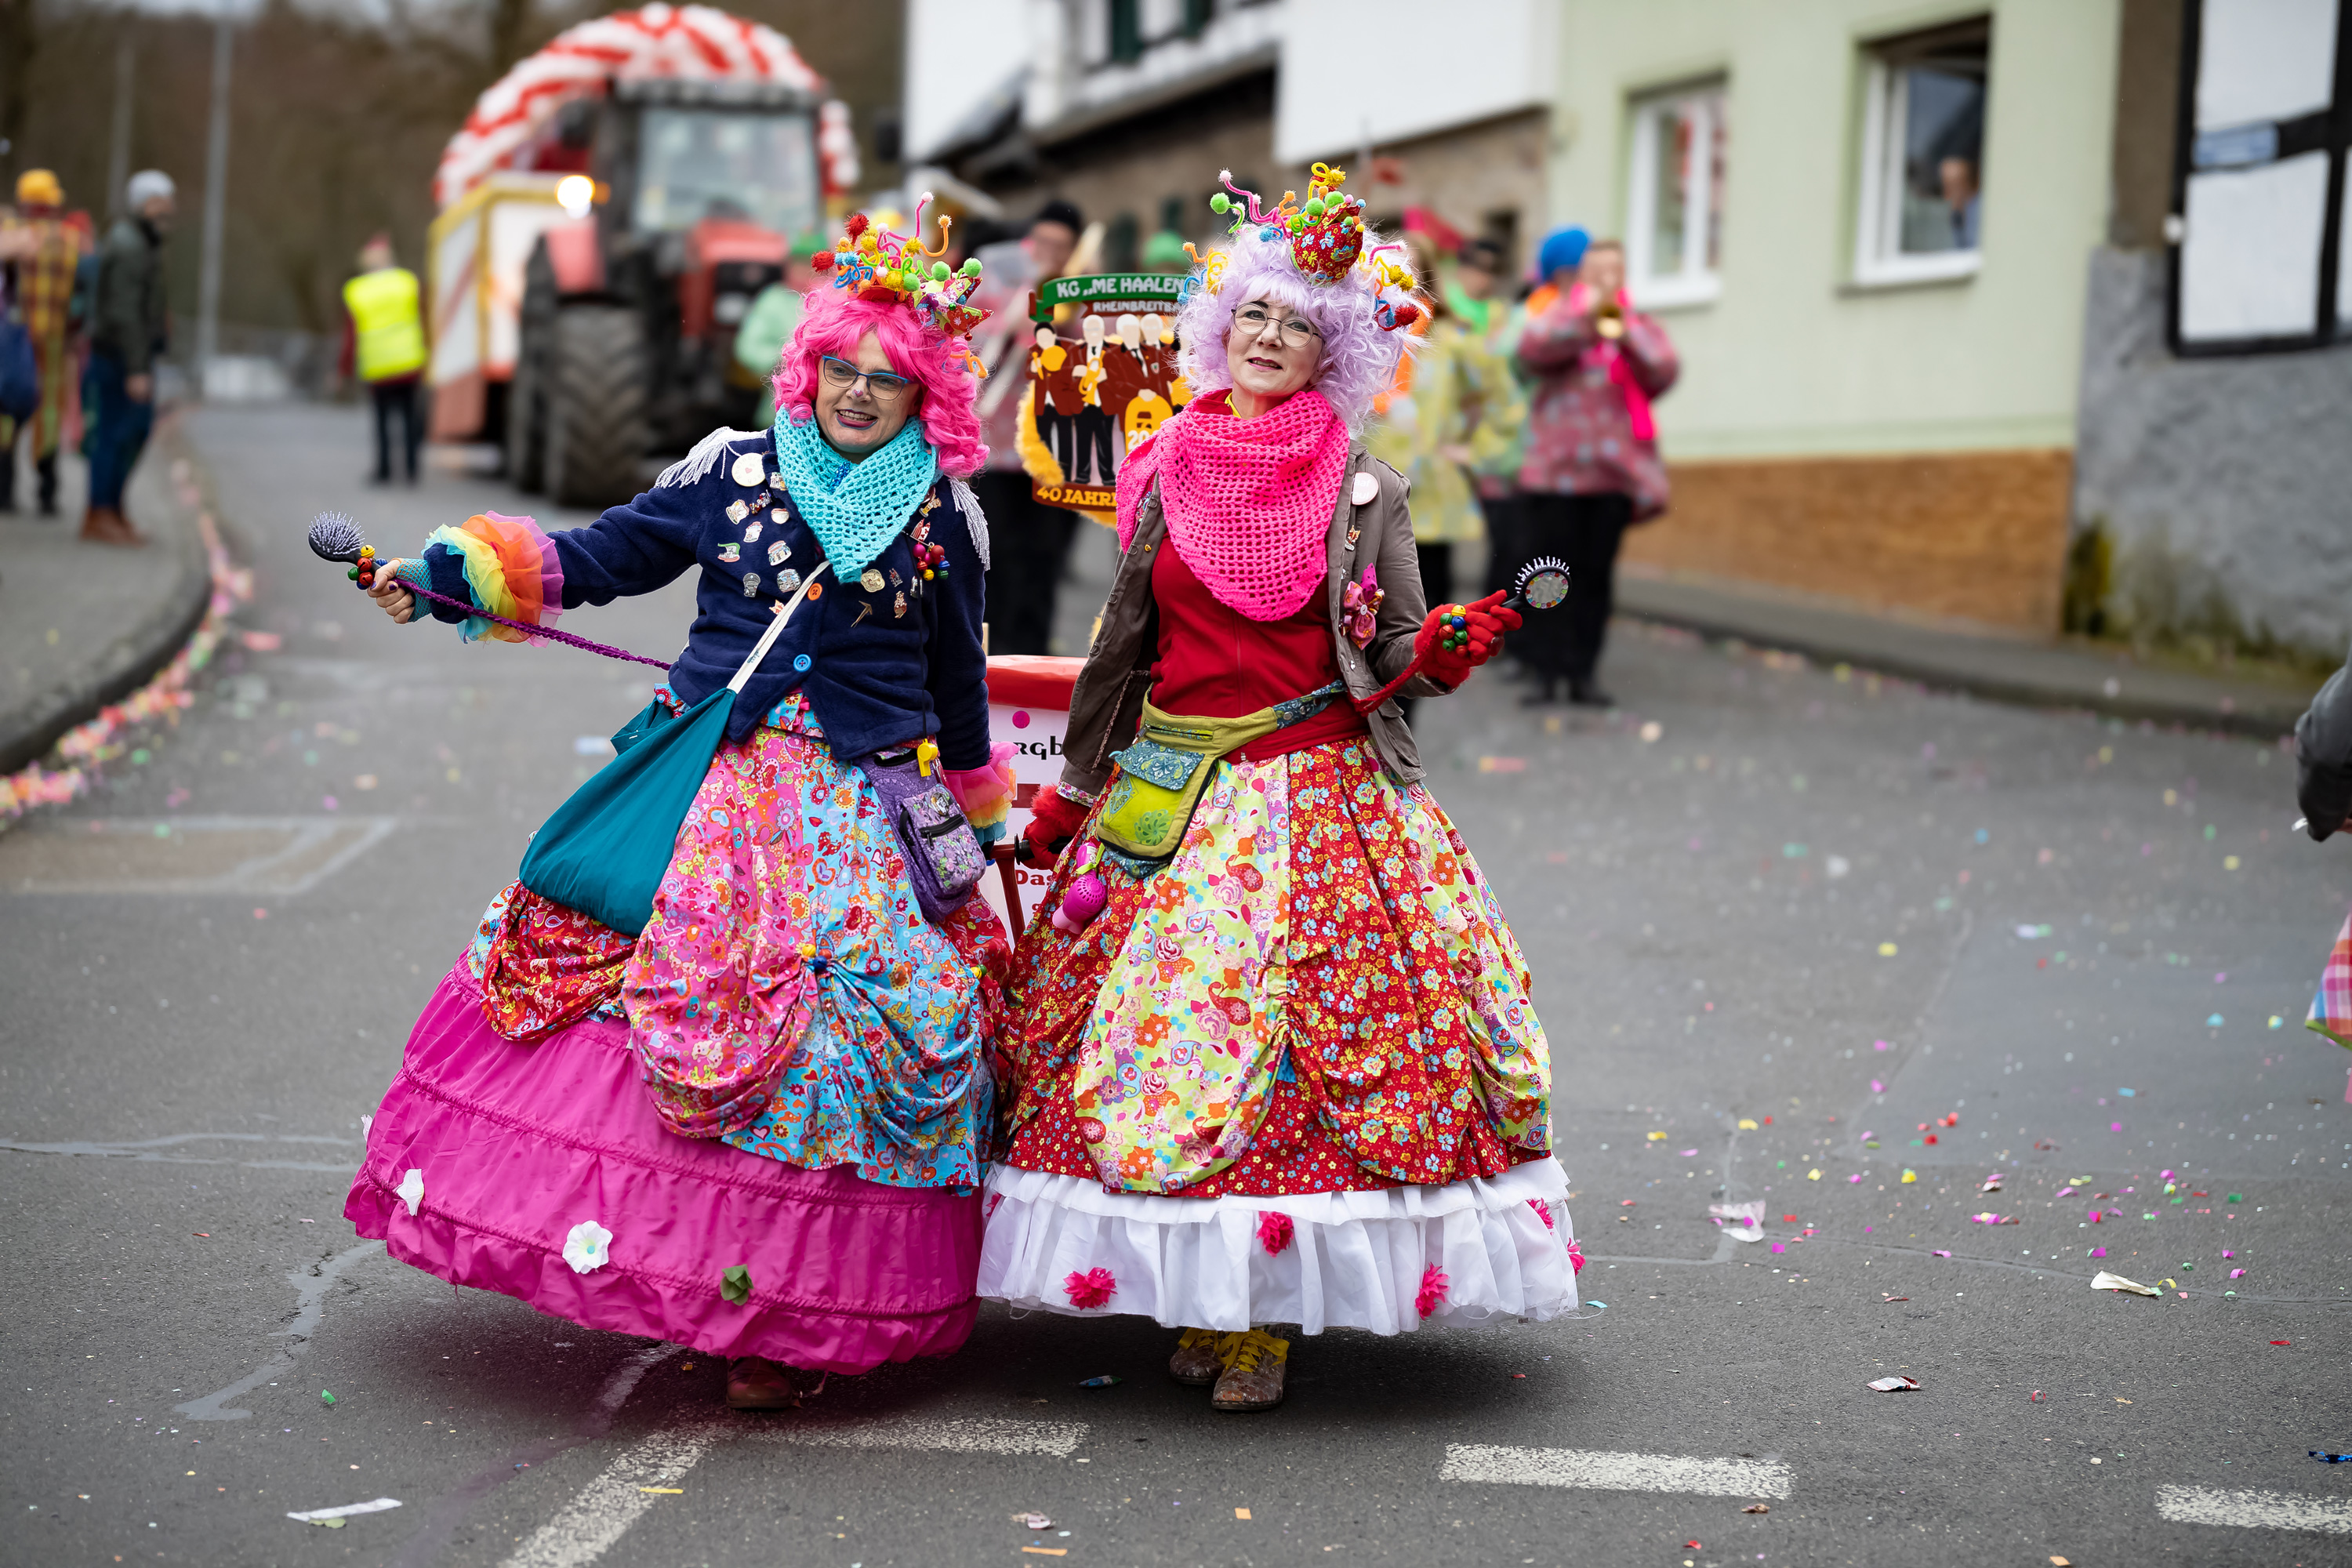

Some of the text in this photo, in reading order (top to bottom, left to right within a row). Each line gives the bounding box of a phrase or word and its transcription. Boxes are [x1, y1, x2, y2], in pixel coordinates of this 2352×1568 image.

[1057, 280, 1080, 298] KG
[1120, 277, 1185, 293] HAALEN
[1036, 486, 1062, 502] 40
